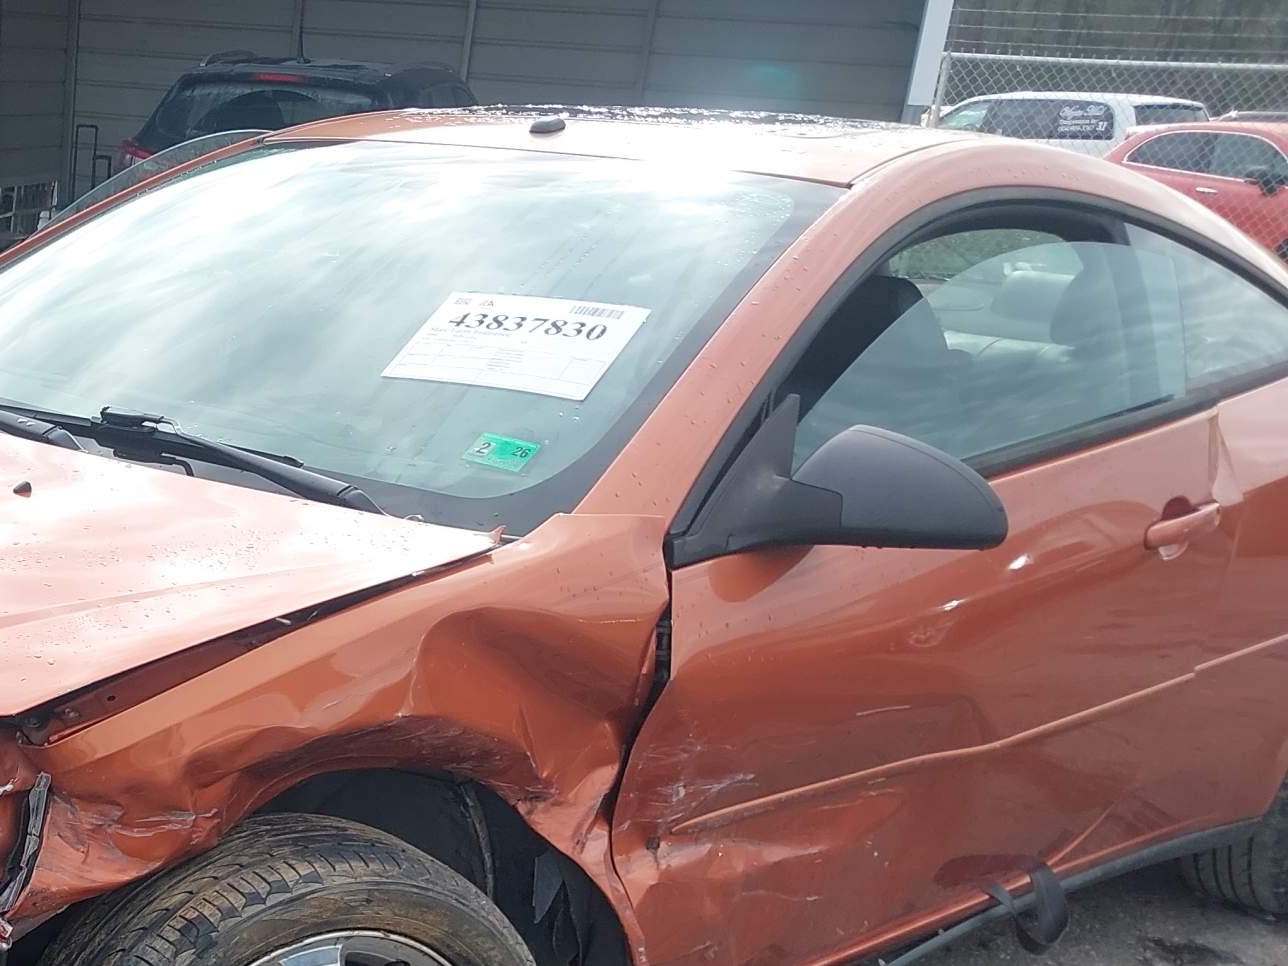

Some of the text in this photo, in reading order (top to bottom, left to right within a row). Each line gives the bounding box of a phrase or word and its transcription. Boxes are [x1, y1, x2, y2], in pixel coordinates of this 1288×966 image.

[448, 311, 608, 341] 43837830
[475, 441, 532, 458] 2 26
